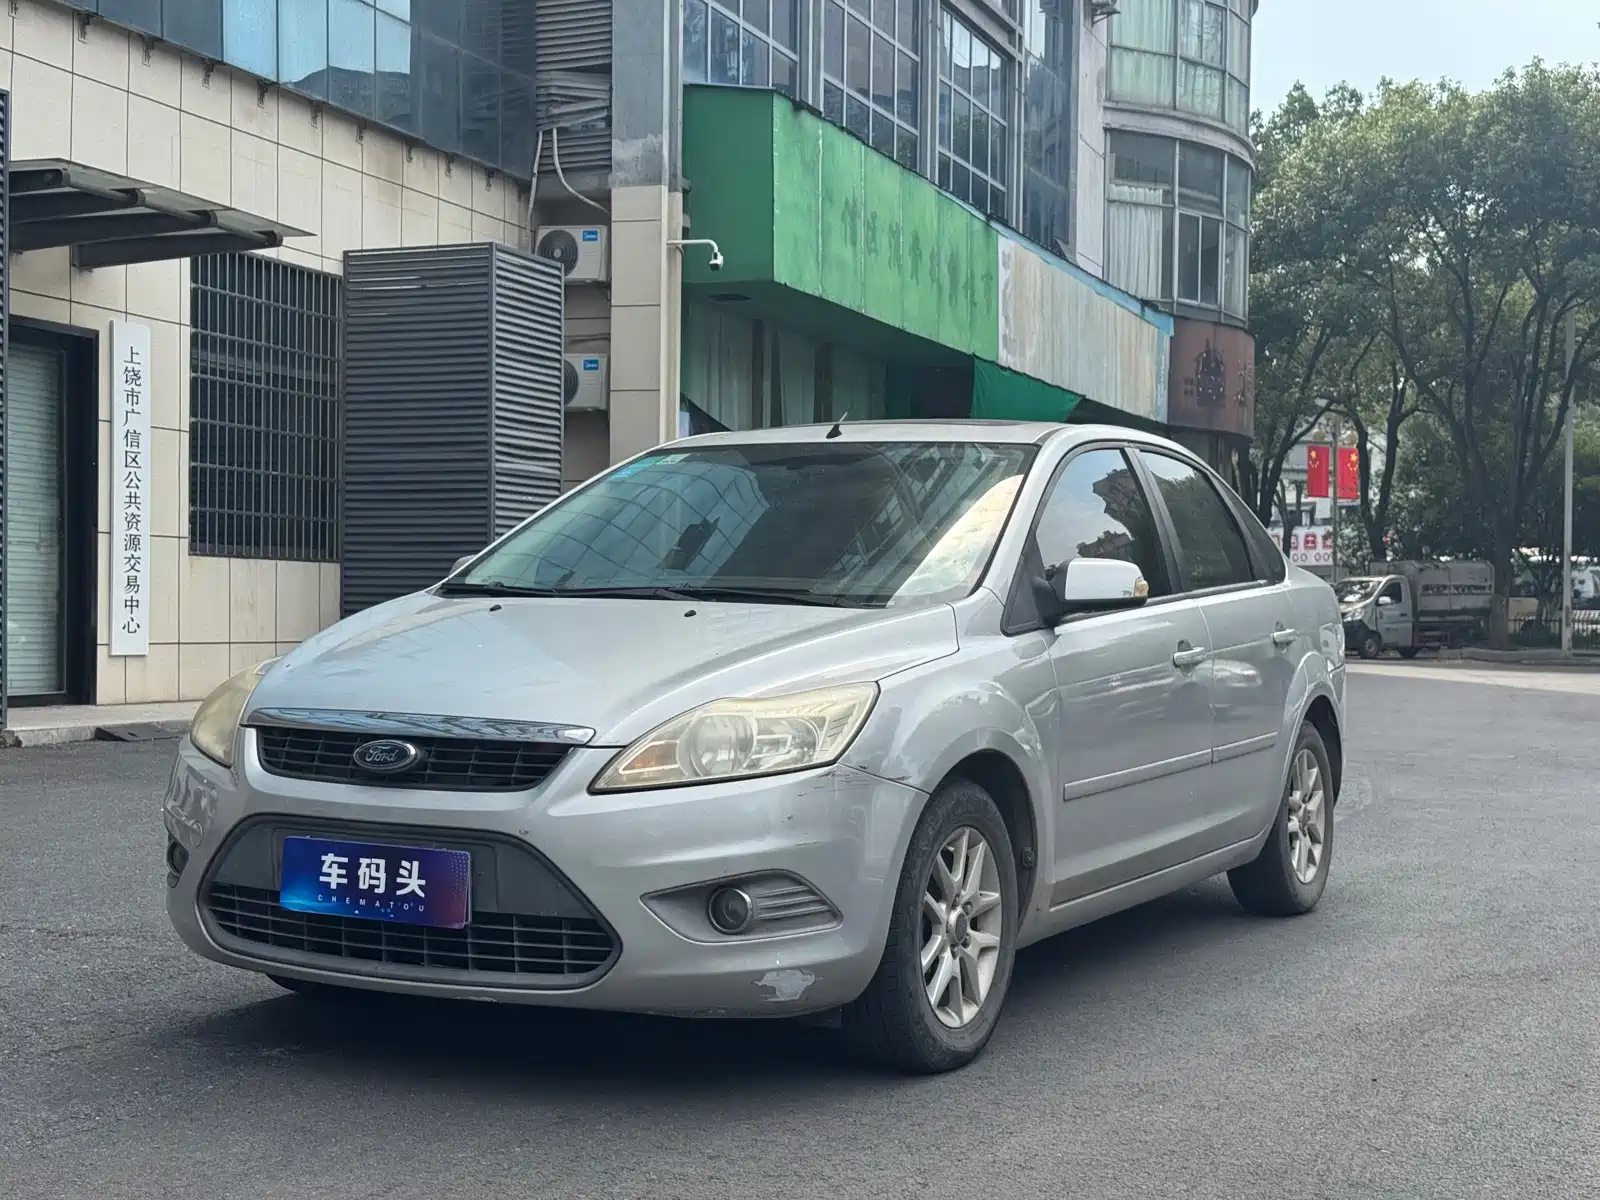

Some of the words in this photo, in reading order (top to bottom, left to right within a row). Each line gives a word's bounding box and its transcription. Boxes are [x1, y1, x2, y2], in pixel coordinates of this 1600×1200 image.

[122, 346, 142, 634] 上饶市广信区公共资源交易中心
[365, 745, 399, 762] Ford
[319, 853, 426, 898] 车码头
[317, 894, 424, 912] CHEMATOU
